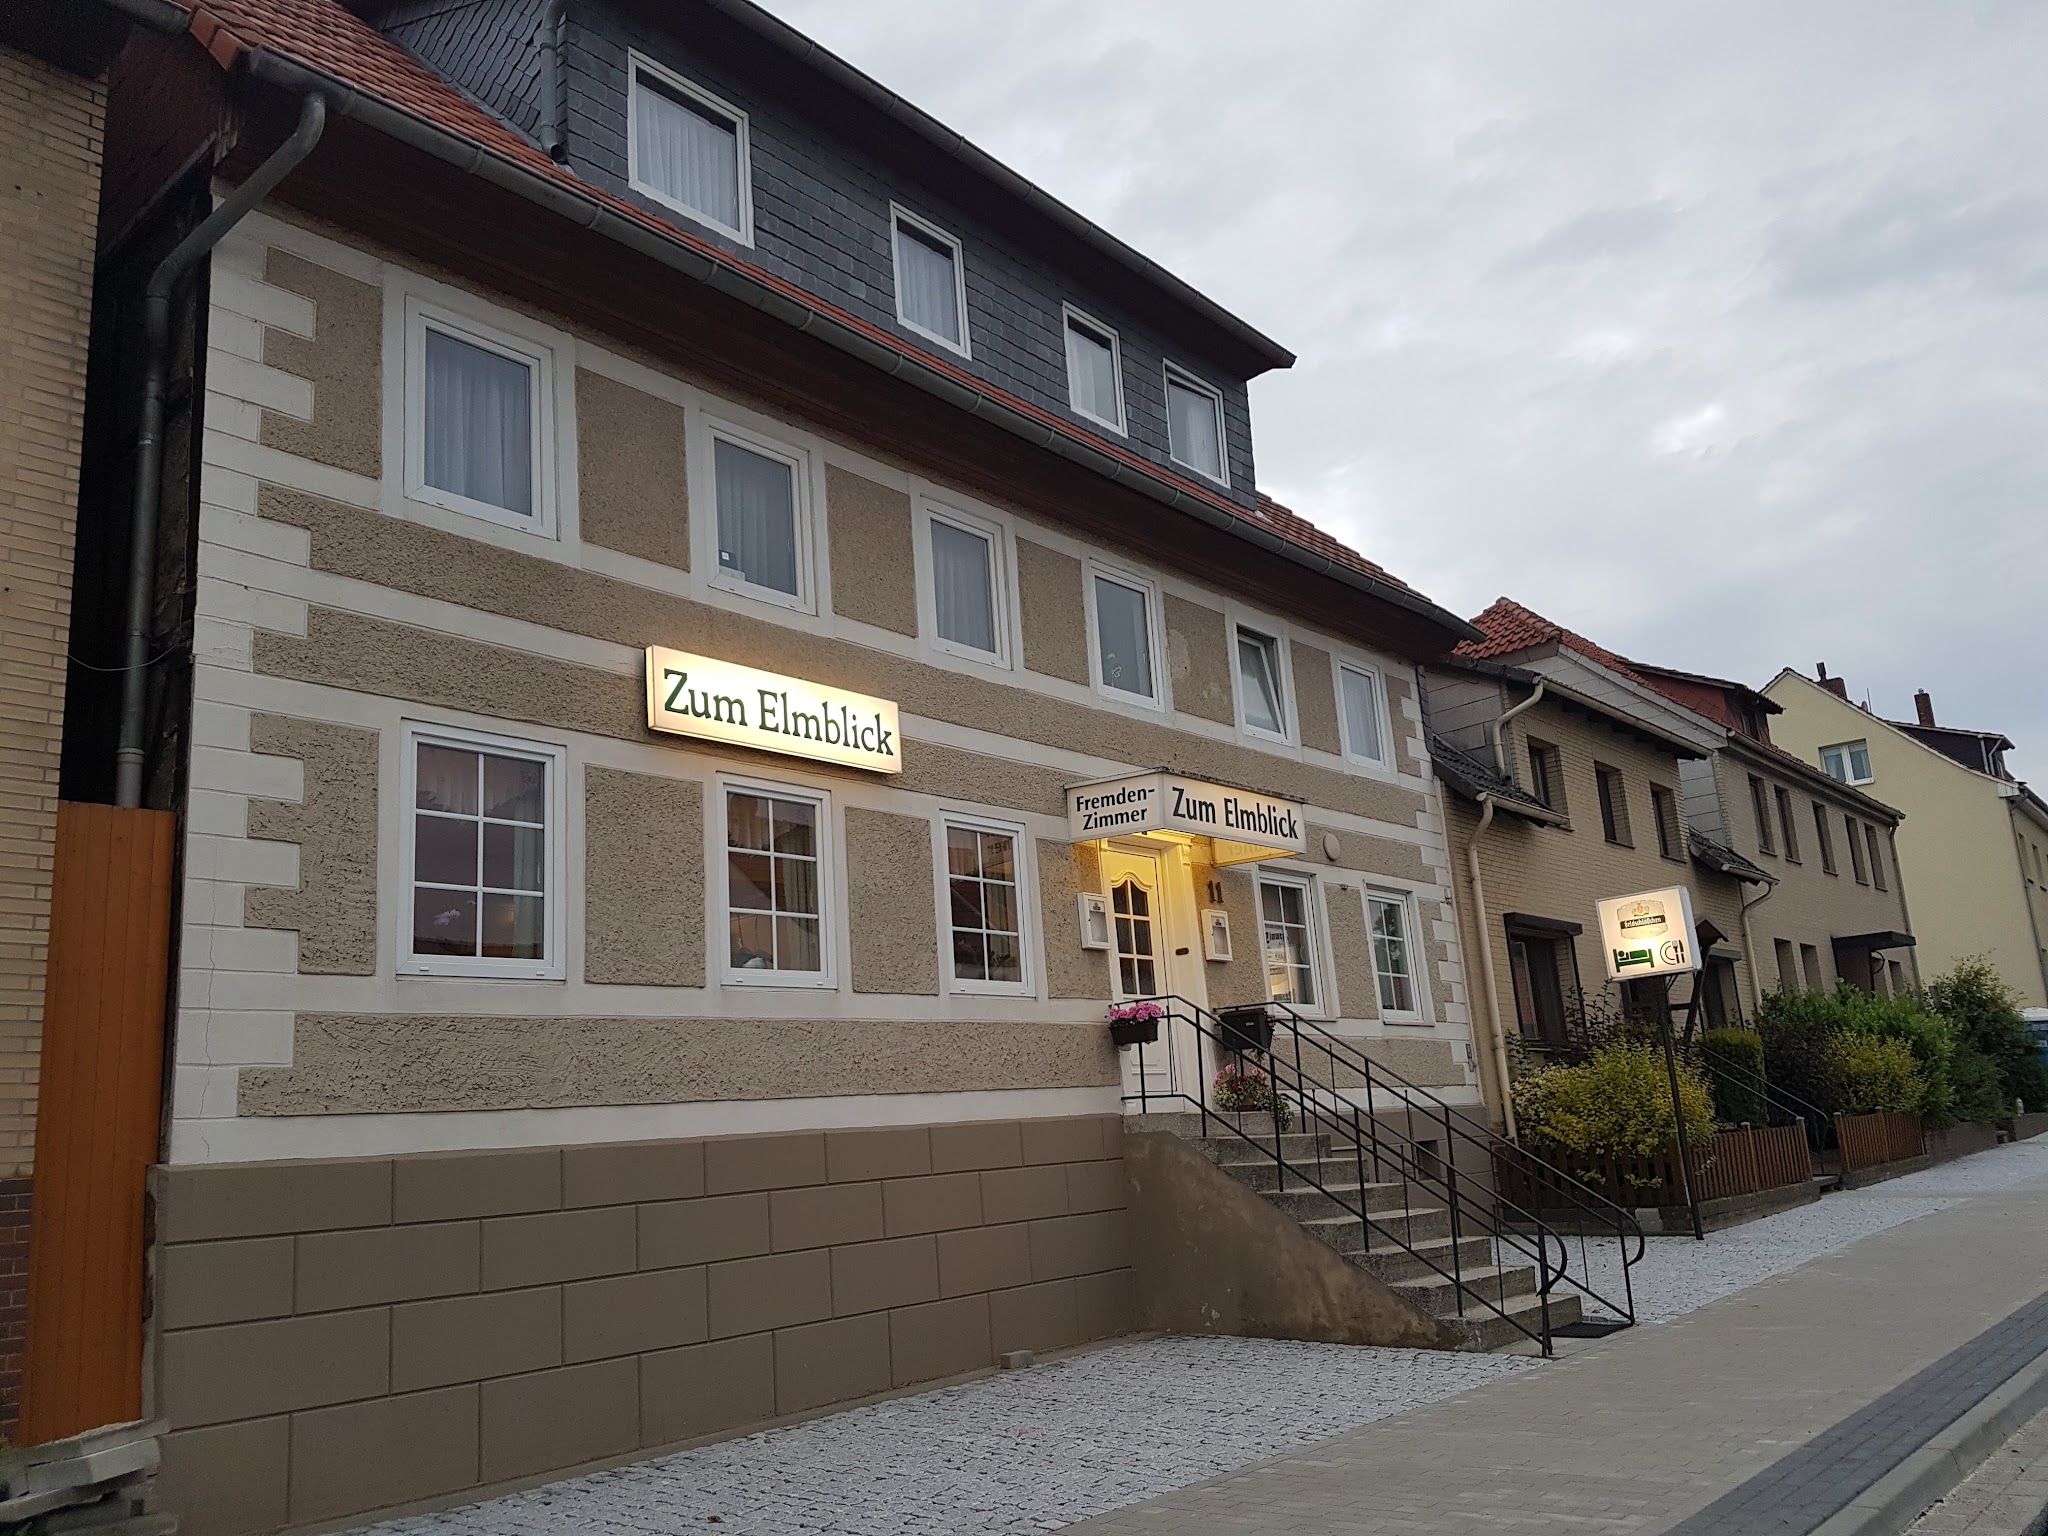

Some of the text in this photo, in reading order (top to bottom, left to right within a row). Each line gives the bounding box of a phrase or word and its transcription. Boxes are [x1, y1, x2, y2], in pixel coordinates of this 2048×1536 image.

[663, 667, 894, 756] Zum Elmblick
[1076, 786, 1156, 812] Fremden-
[1082, 807, 1148, 831] Zimmer
[1171, 786, 1299, 840] Zum Elmblick
[1207, 880, 1224, 903] 11
